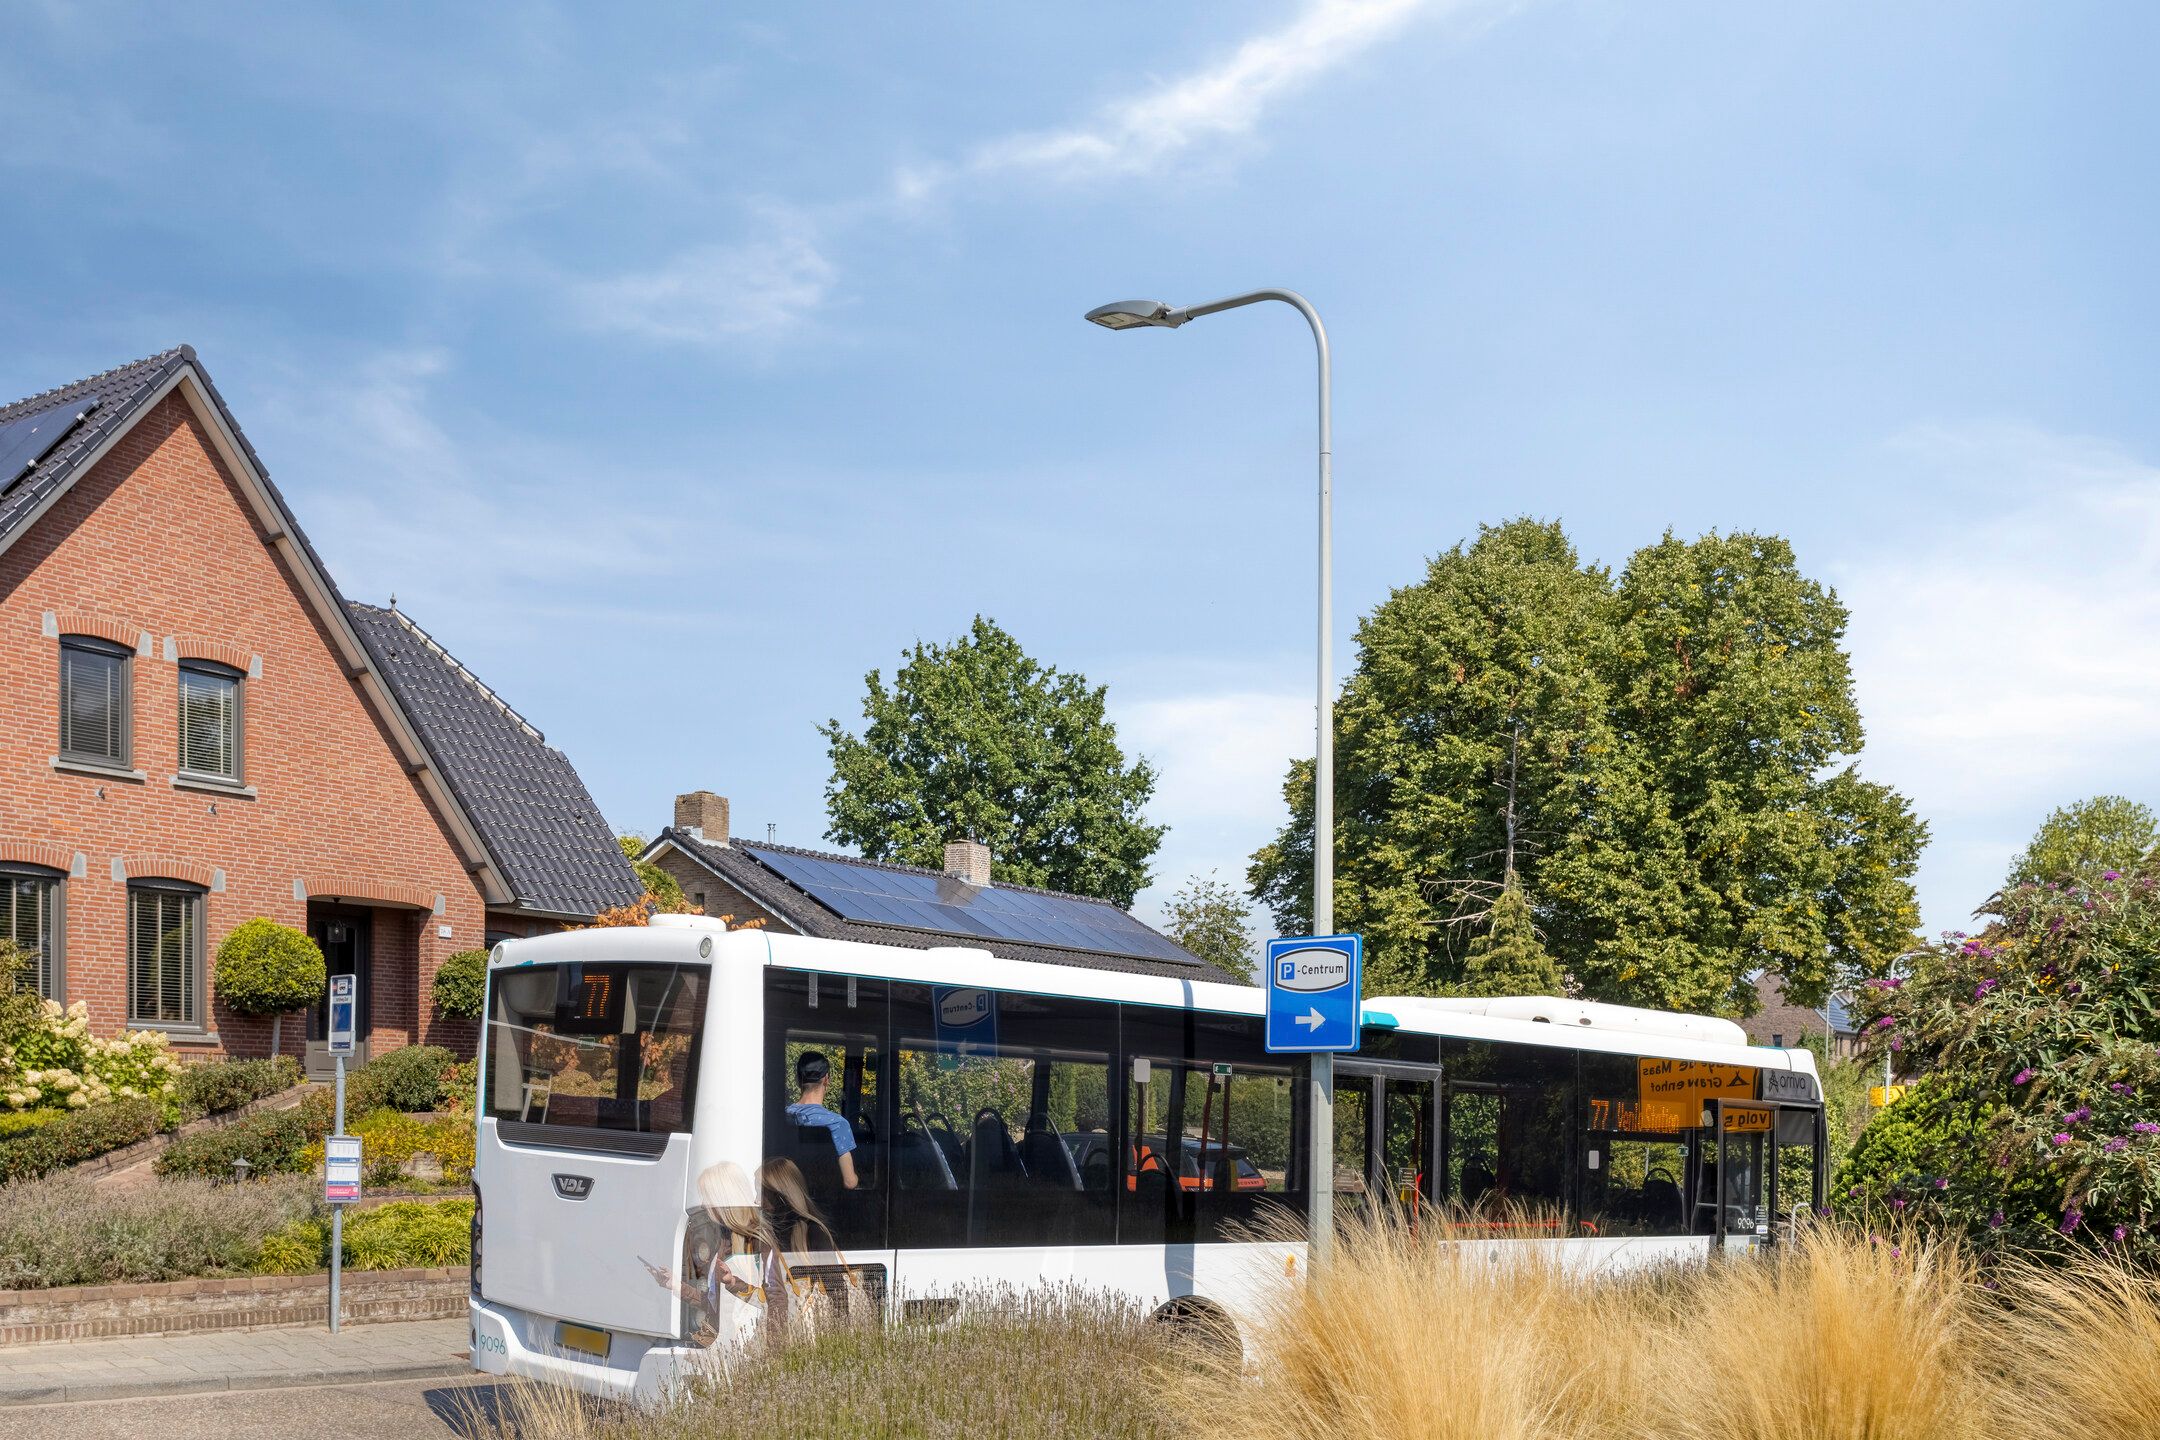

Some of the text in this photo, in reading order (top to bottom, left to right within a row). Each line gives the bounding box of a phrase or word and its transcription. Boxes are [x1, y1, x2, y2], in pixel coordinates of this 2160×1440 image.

[1297, 964, 1344, 975] -Centrum
[584, 975, 611, 1018] 77
[1780, 1075, 1806, 1090] arriva
[1591, 1099, 1610, 1130] 77
[558, 1177, 586, 1193] VDL
[480, 1334, 506, 1355] 9096
